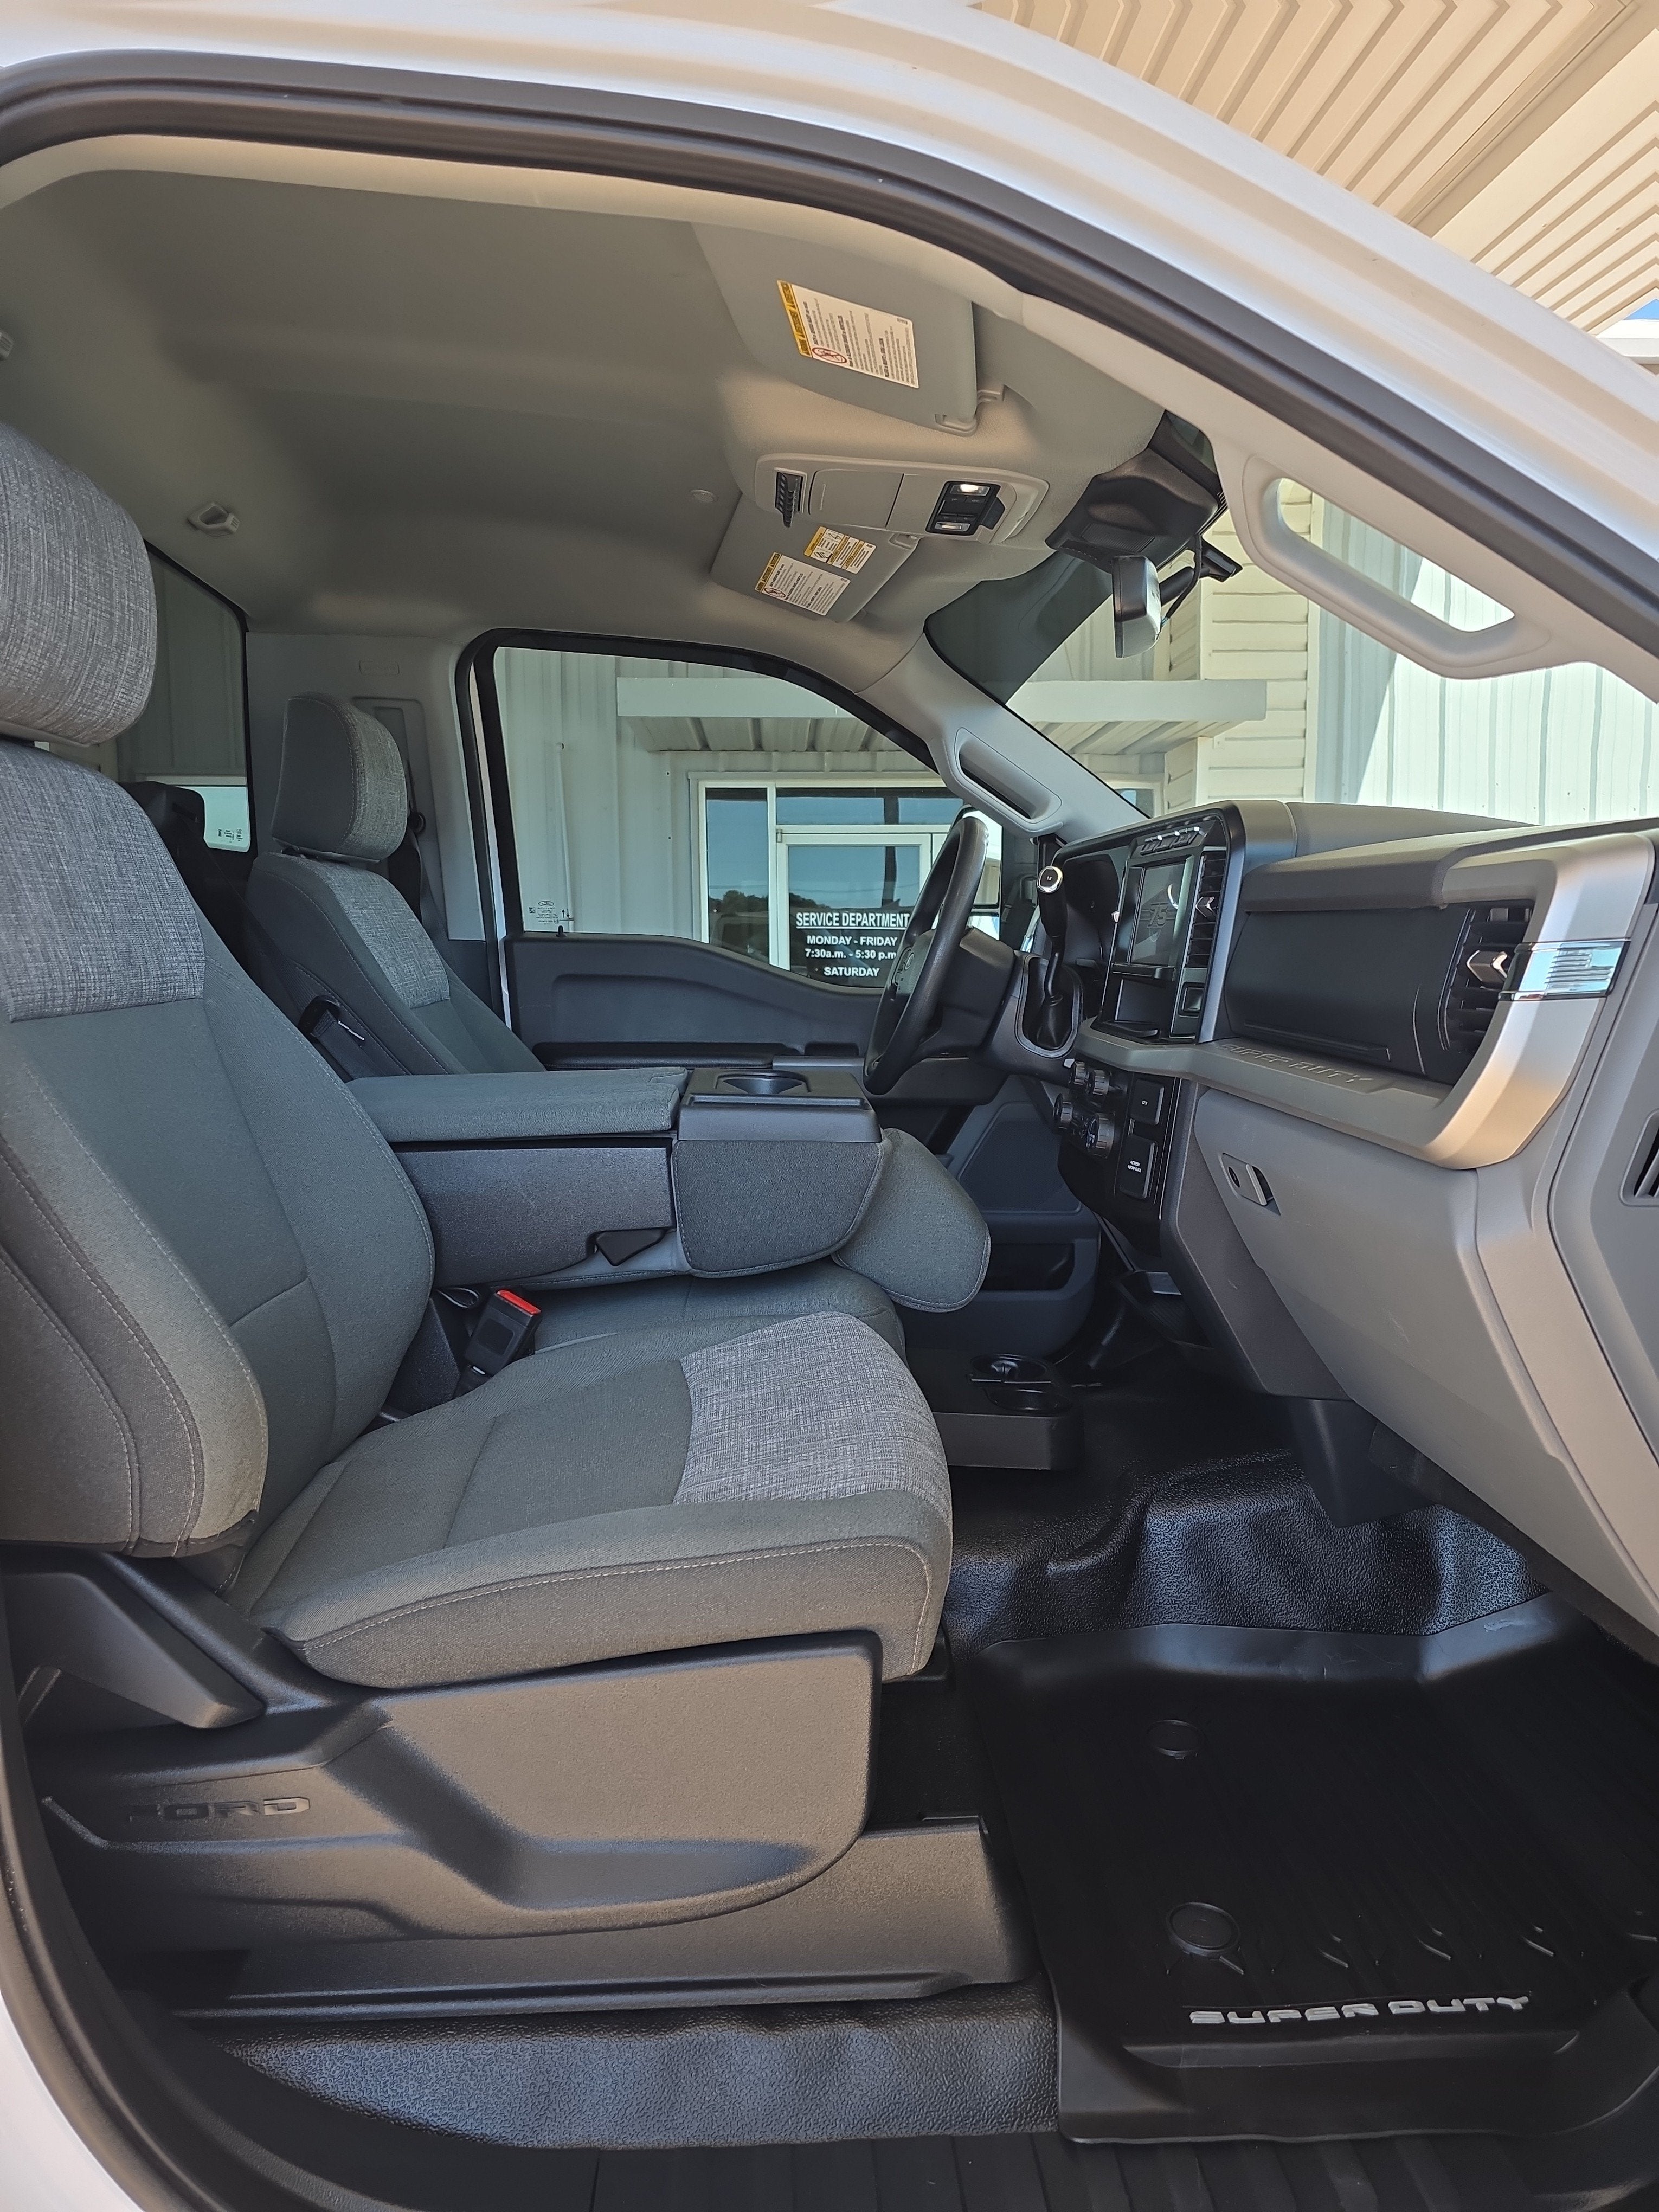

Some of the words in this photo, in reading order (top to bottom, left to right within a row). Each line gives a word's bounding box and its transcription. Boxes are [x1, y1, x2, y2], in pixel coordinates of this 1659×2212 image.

[796, 912, 840, 927] SERVICE
[841, 912, 910, 927] DEPARTMENT
[806, 935, 852, 945] MONDAY
[859, 936, 898, 946] FRIDAY
[805, 948, 846, 958] 7:30a.m.
[855, 950, 876, 959] 5:30
[824, 967, 880, 976] SATURDAY
[1218, 1044, 1293, 1062] SUPER
[1289, 1062, 1374, 1083] DUTY
[1190, 2003, 1379, 2024] SUPER
[1388, 1996, 1529, 2014] DUTY
